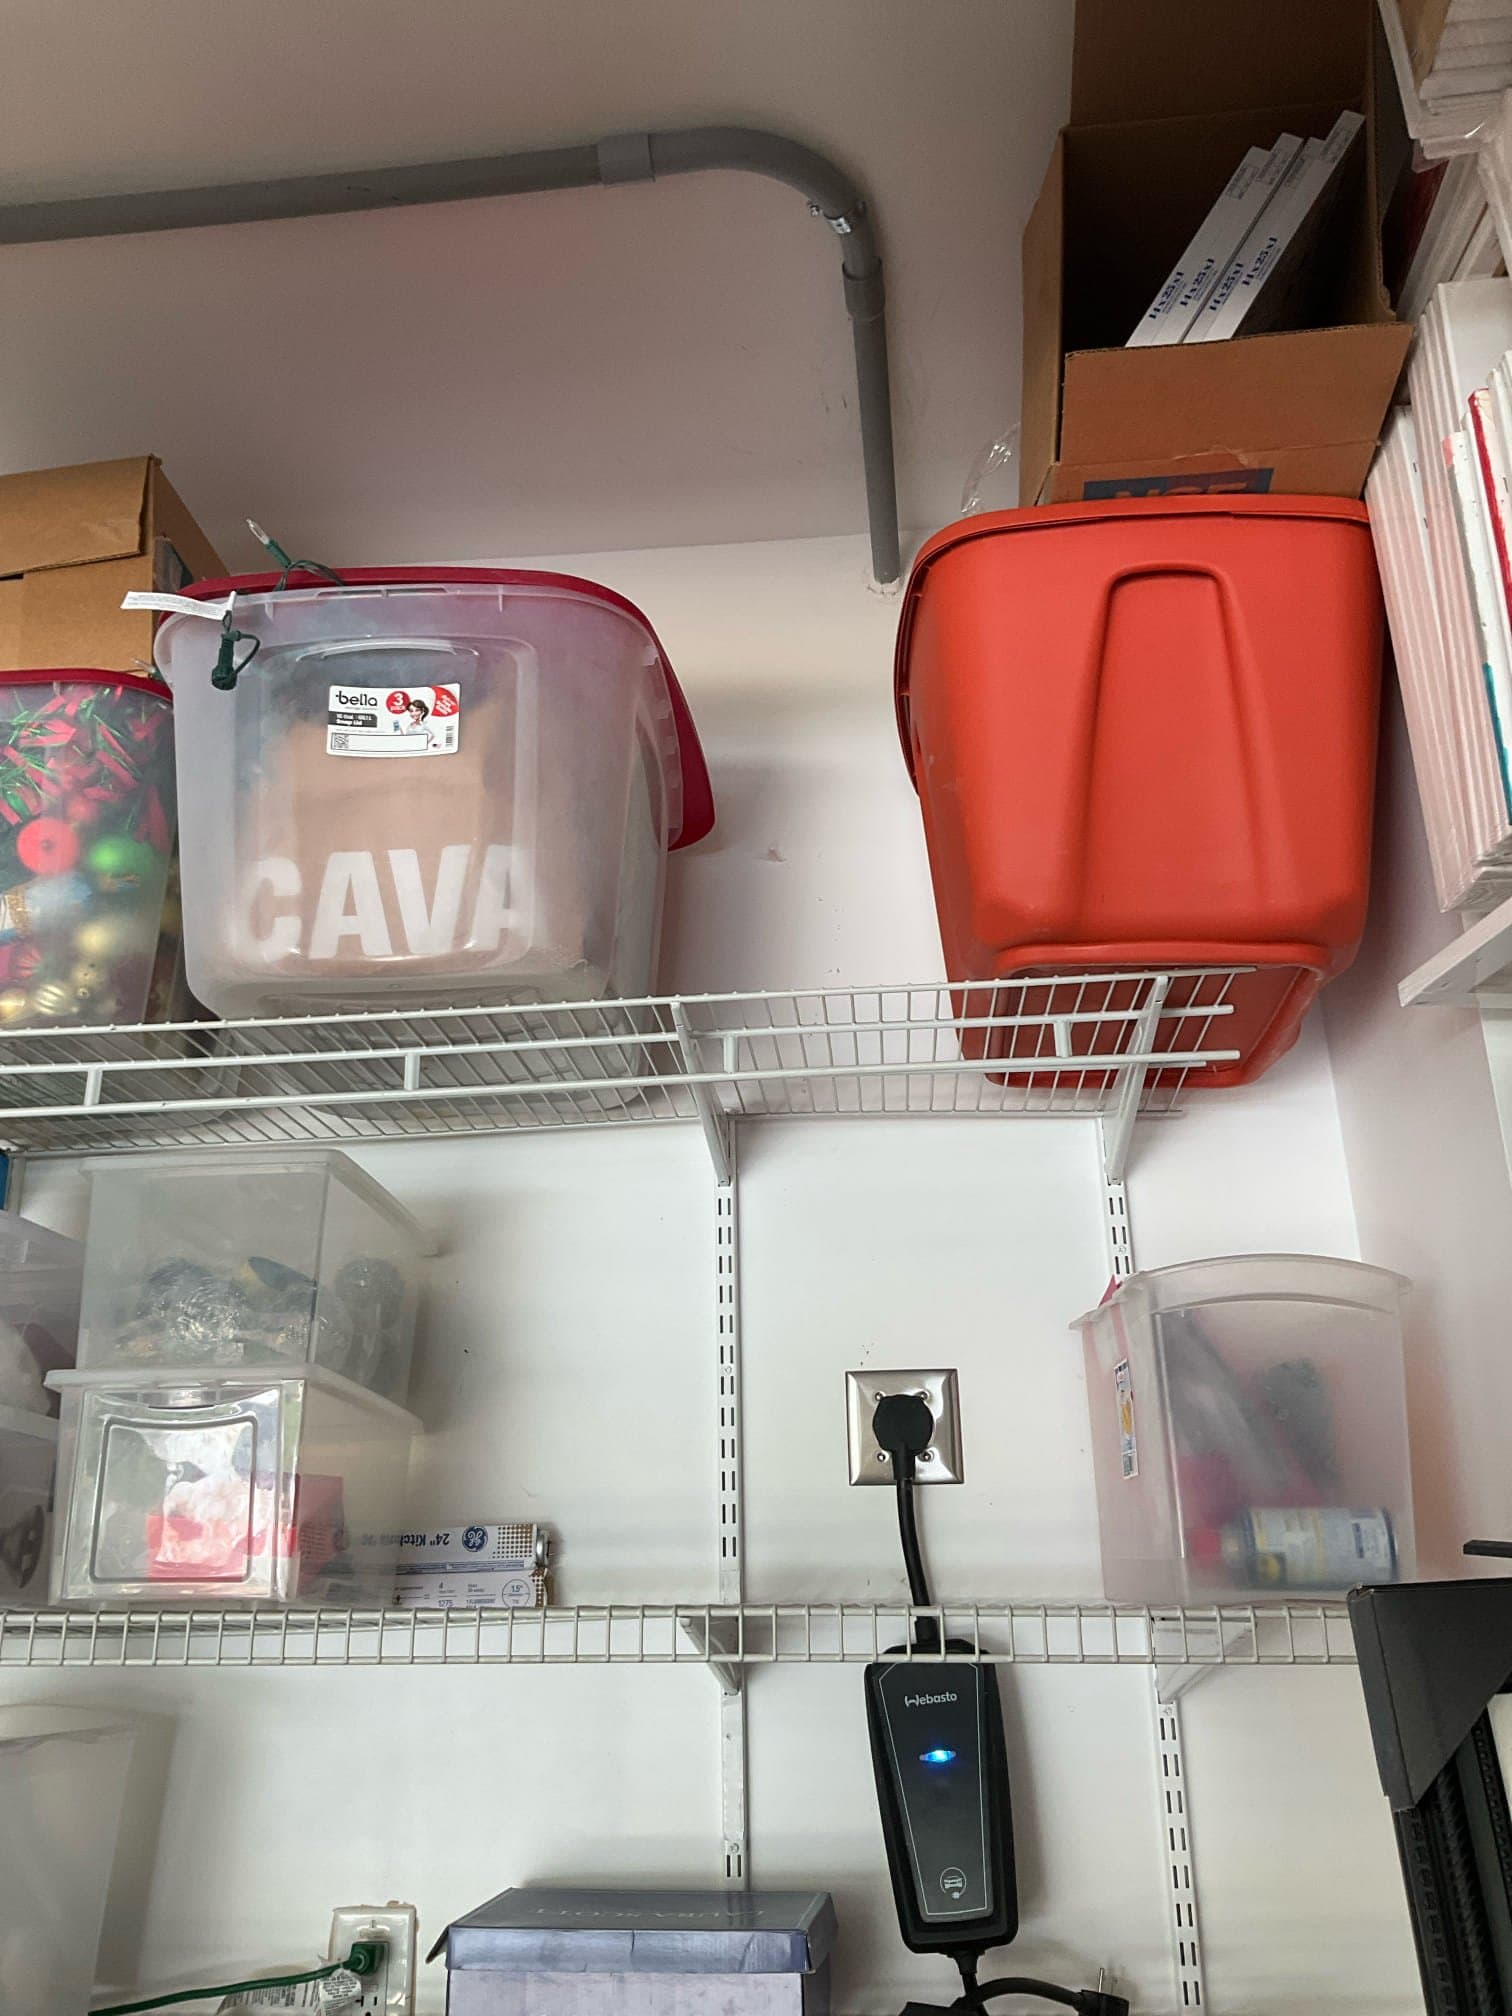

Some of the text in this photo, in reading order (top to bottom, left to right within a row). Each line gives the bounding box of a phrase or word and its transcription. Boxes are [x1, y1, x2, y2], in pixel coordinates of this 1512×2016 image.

[336, 690, 378, 707] bella
[393, 692, 404, 706] 3
[235, 843, 532, 966] CAVA
[904, 1691, 958, 1707] Webasto
